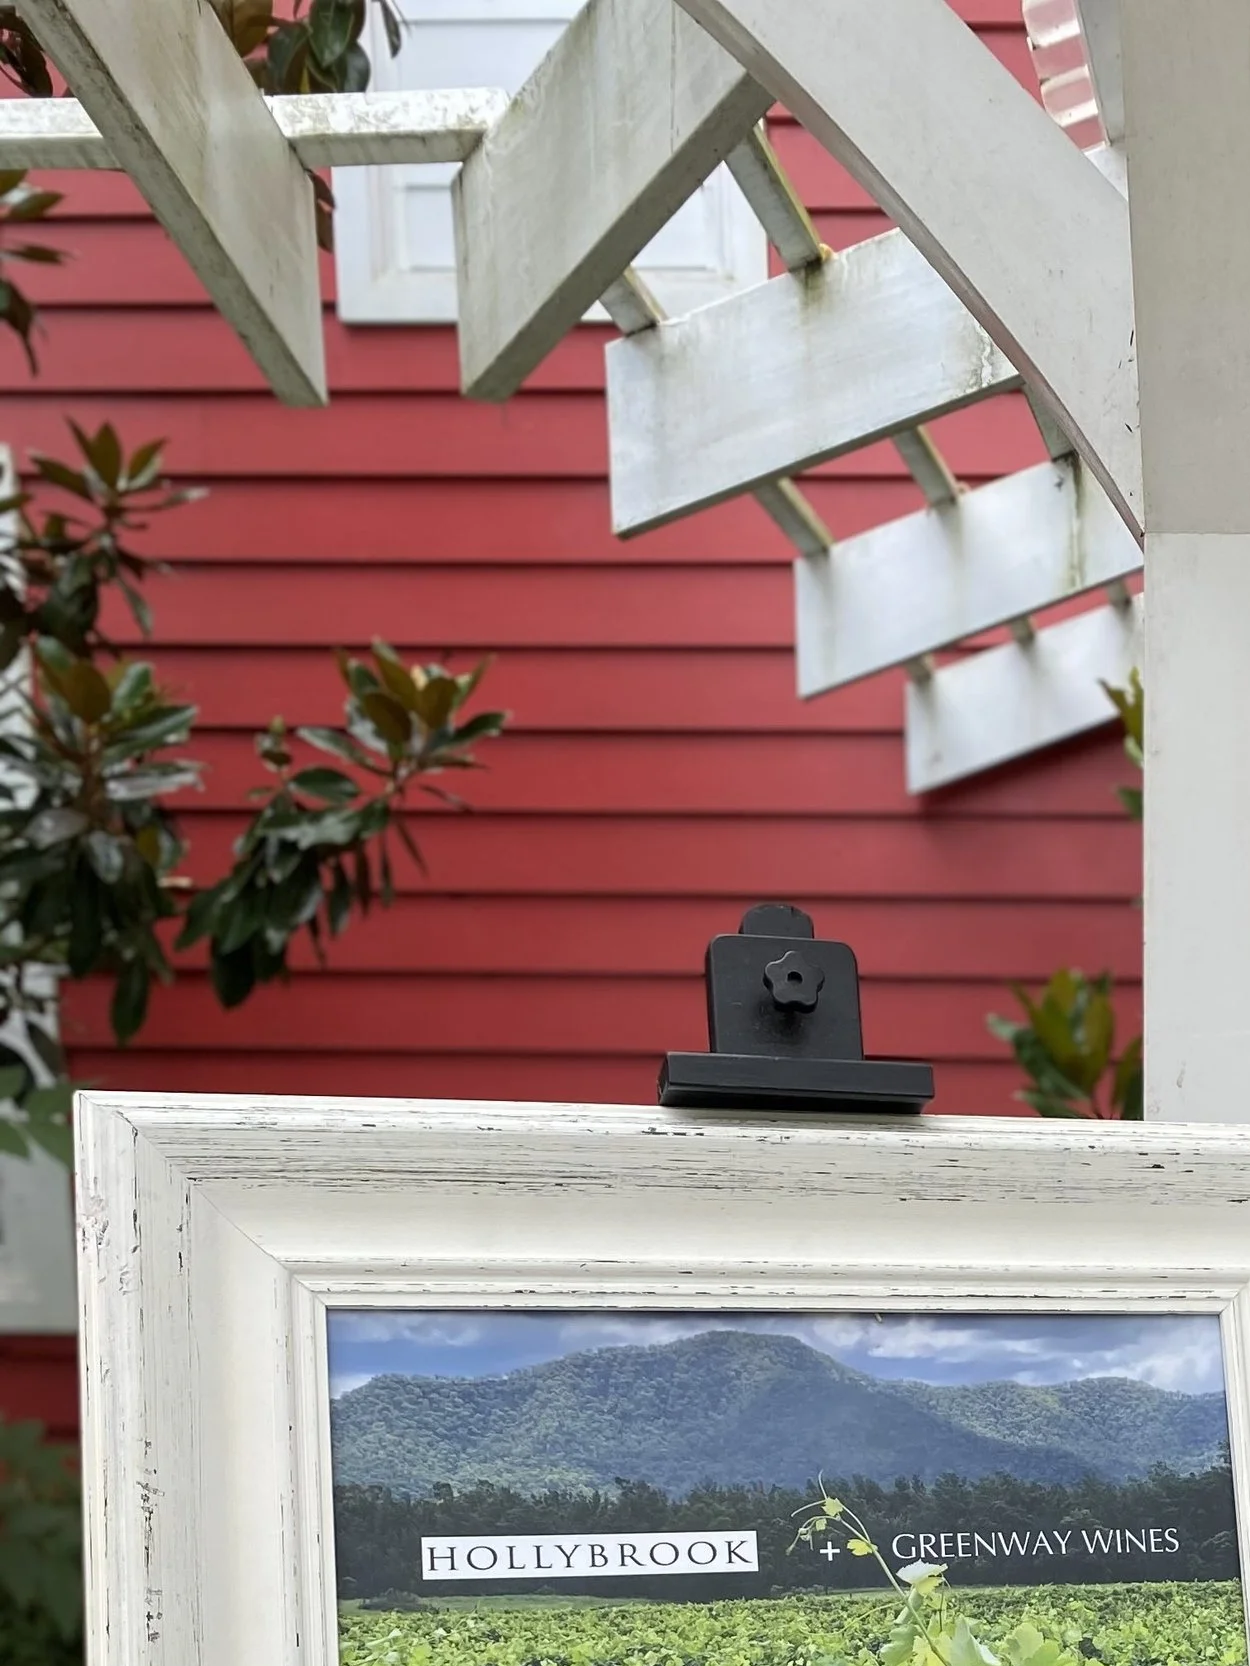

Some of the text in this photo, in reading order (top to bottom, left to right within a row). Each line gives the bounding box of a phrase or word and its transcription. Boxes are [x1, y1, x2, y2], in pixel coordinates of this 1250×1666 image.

[427, 1540, 753, 1572] HOLLYBROOK
[892, 1530, 1072, 1559] GREENWAY
[1081, 1528, 1180, 1554] WINES
